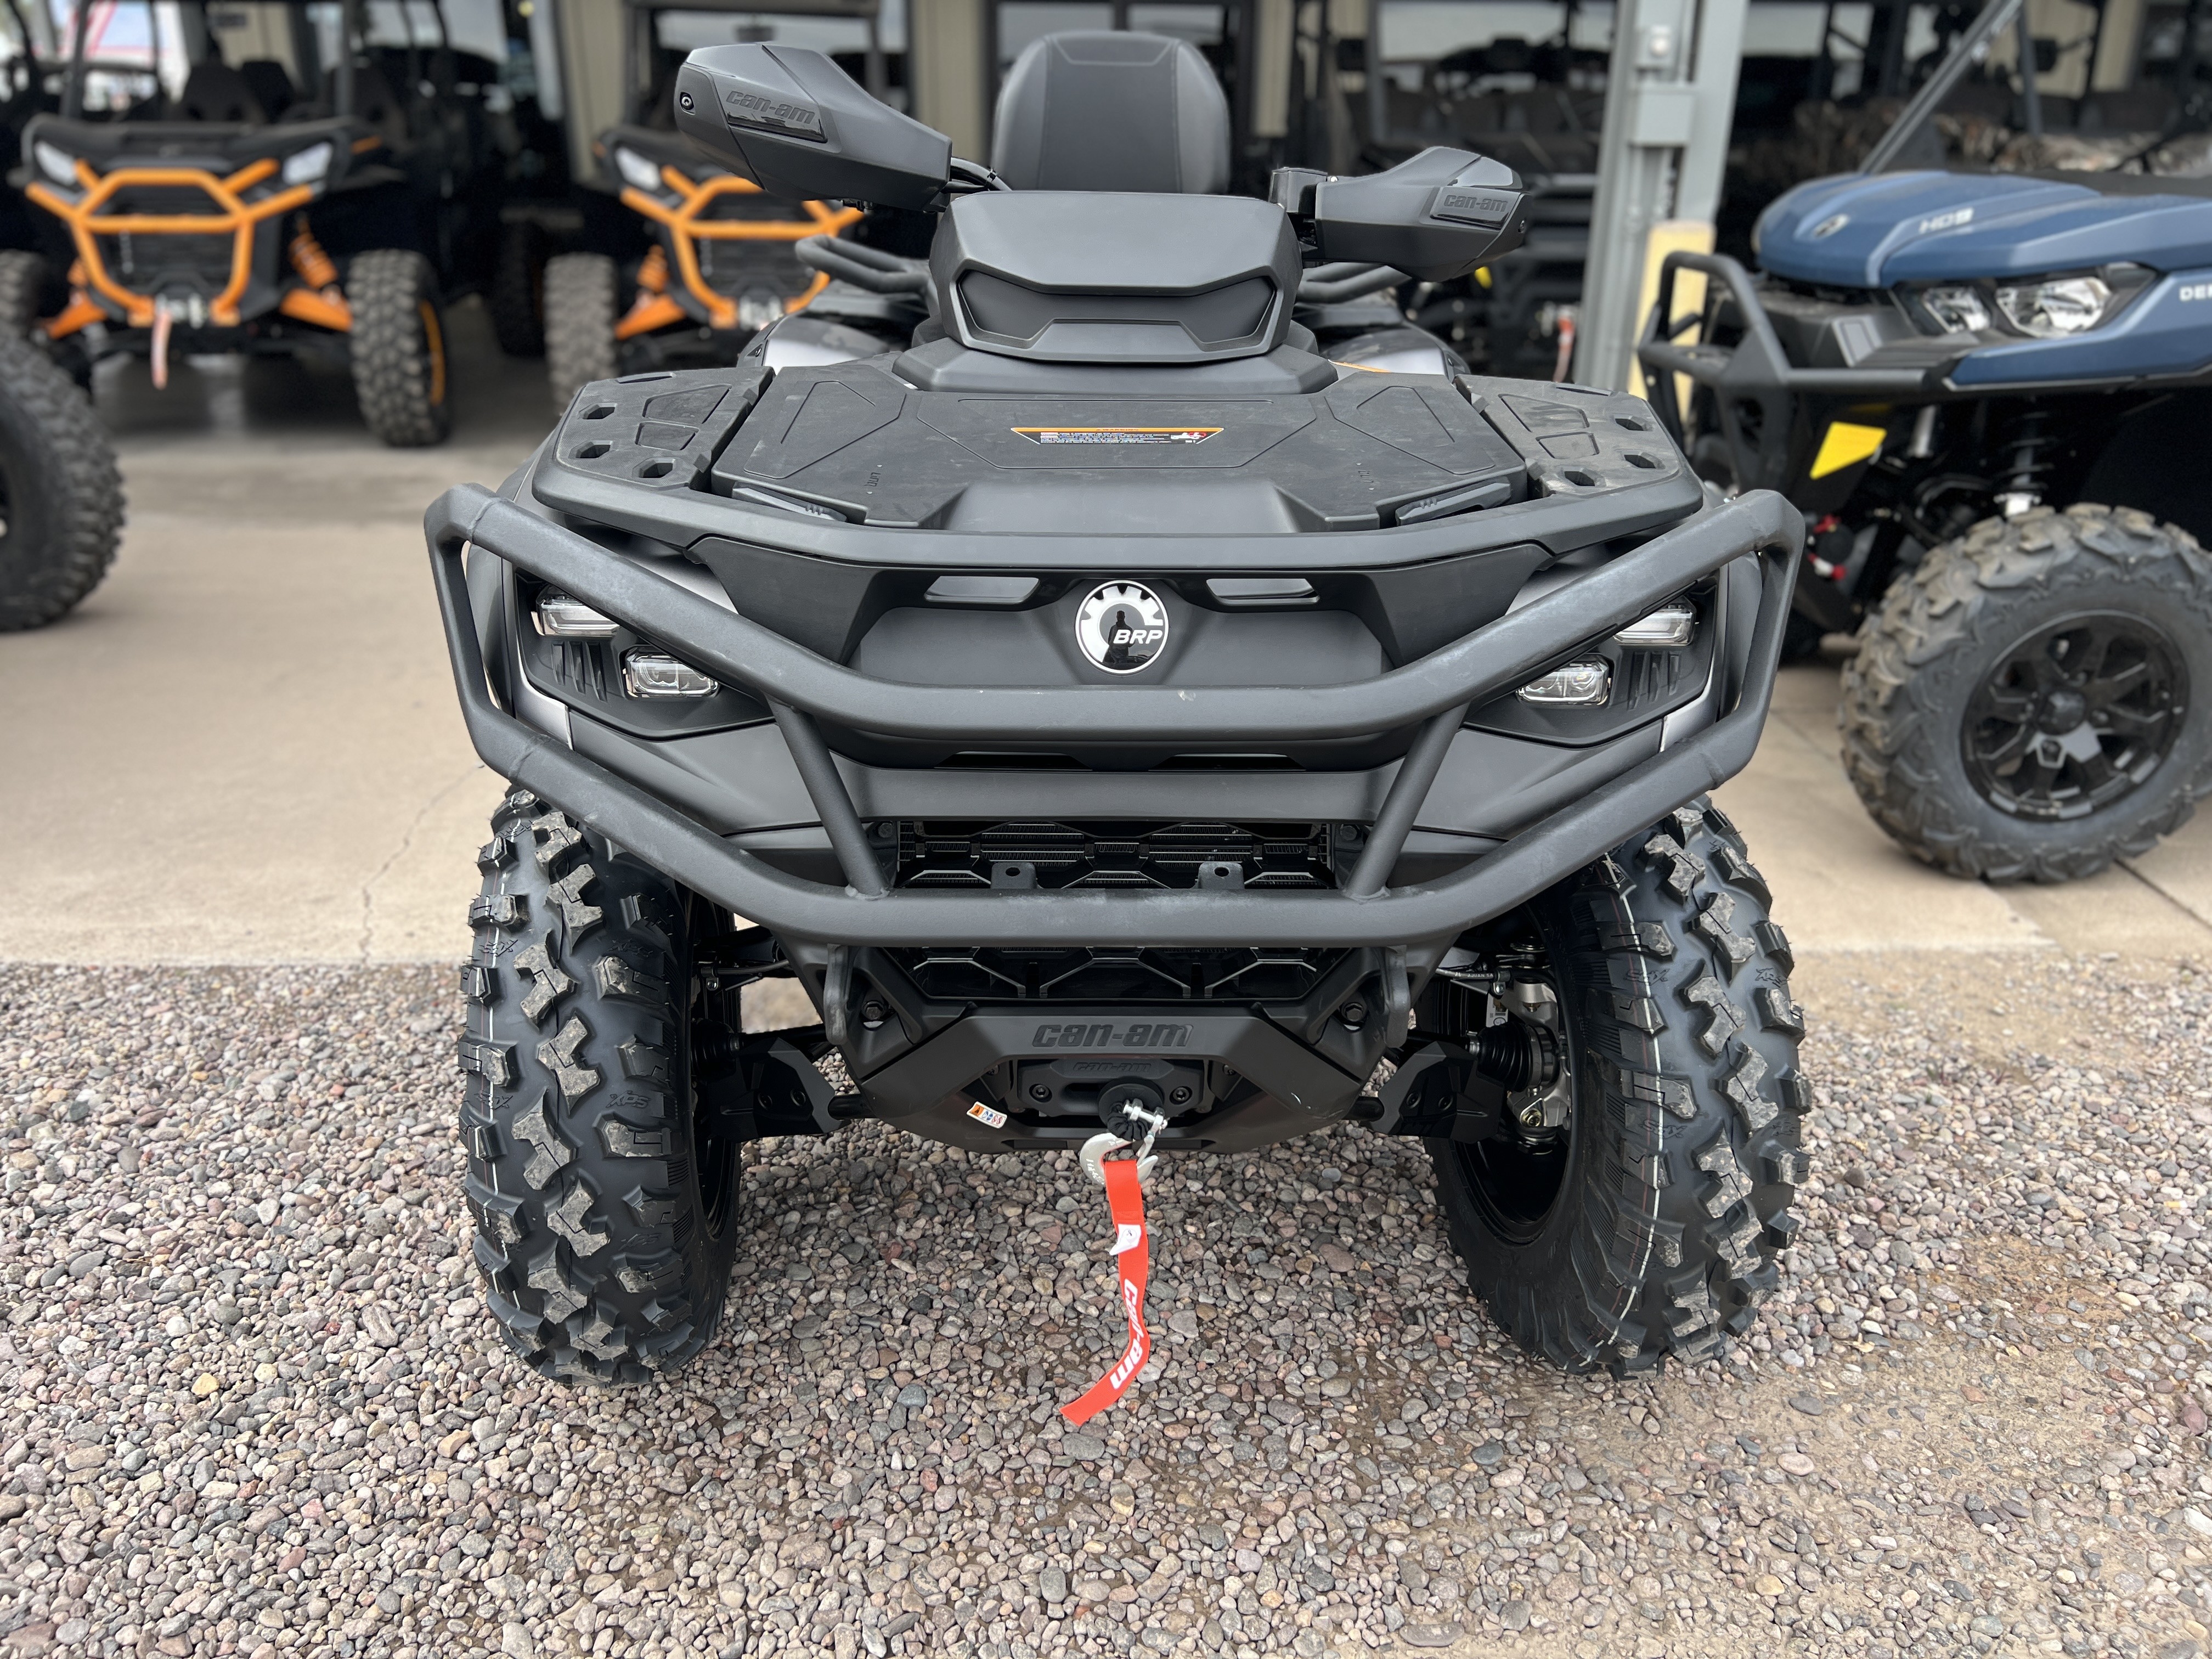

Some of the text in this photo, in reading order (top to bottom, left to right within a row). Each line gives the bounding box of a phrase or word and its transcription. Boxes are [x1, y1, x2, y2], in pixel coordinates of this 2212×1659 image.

[726, 91, 815, 124] can-am
[1443, 195, 1508, 212] can-am
[1113, 629, 1163, 644] BRP
[1032, 1024, 1193, 1047] can-am
